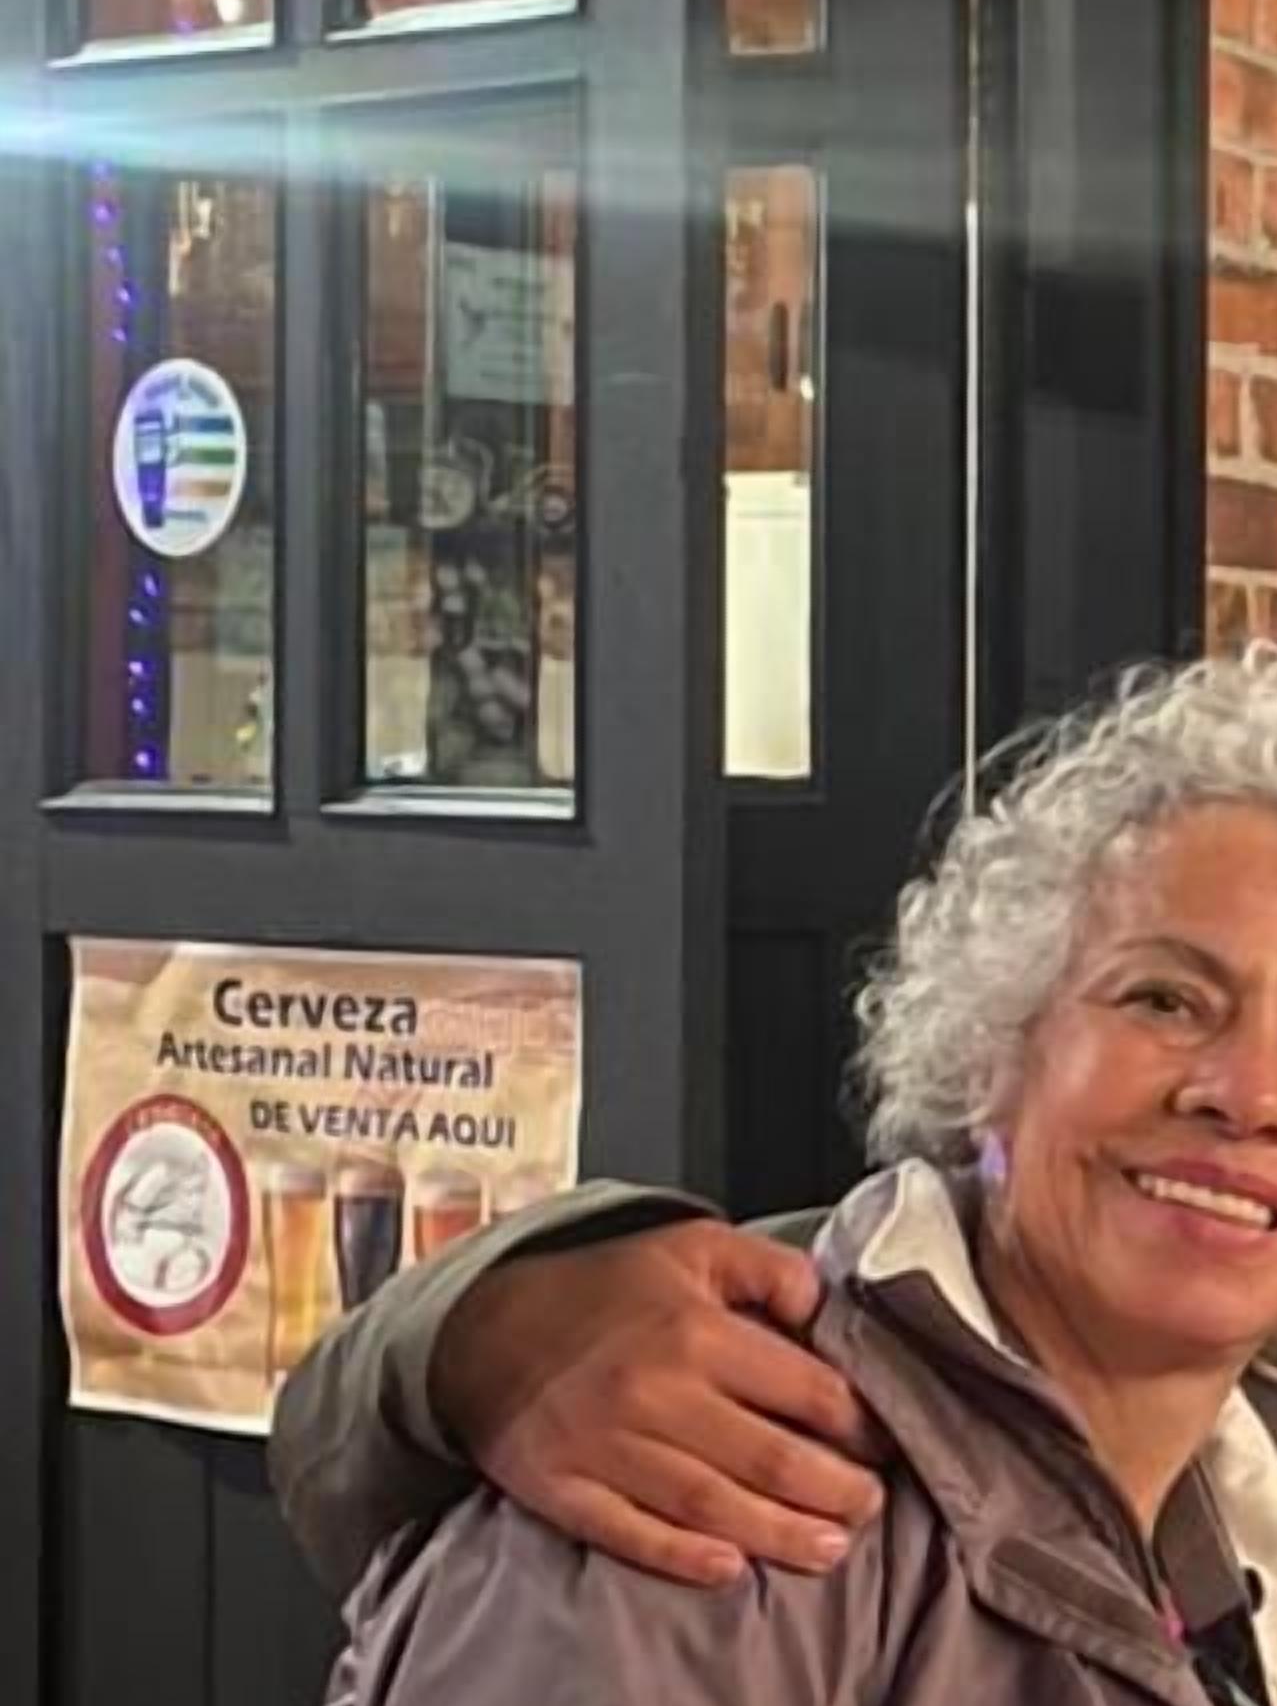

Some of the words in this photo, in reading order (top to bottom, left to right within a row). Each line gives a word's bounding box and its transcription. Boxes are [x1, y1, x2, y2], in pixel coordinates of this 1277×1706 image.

[213, 977, 418, 1035] Cerveza
[156, 1032, 332, 1079] Artesanal
[344, 1045, 493, 1089] Natural
[250, 1101, 290, 1133] DE
[299, 1106, 420, 1142] VENTA
[428, 1112, 516, 1150] AQUI
